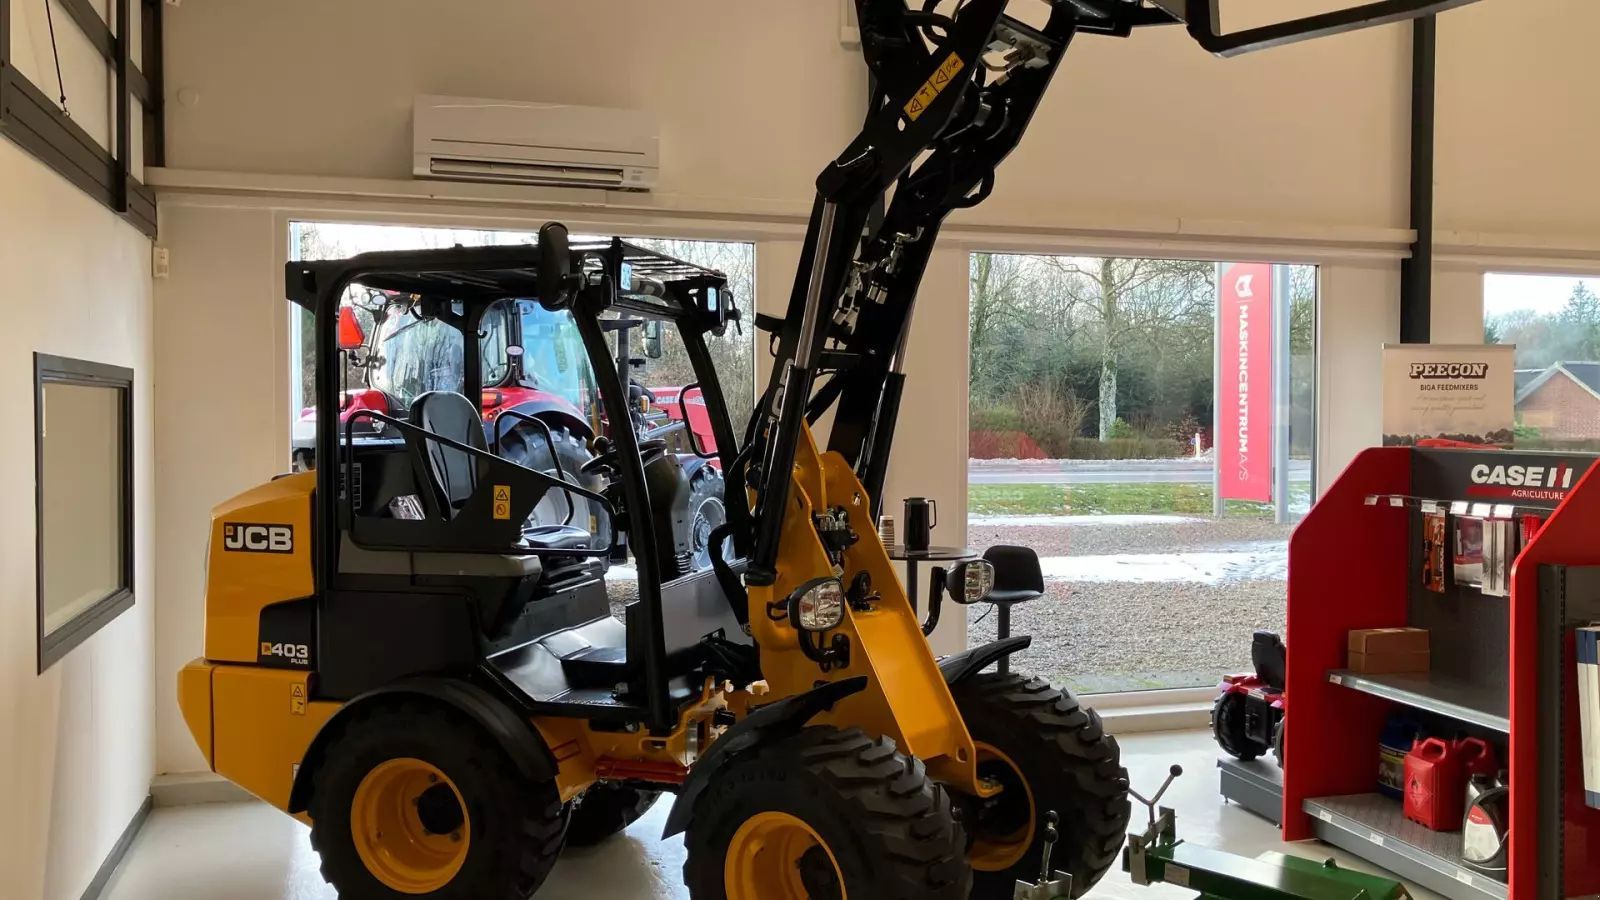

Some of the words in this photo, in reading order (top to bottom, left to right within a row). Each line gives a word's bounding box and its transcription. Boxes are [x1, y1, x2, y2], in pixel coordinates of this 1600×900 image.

[1409, 363, 1489, 379] PEECON
[1471, 464, 1544, 487] CASE
[1511, 489, 1564, 500] AGRICULTURE
[225, 525, 292, 551] JCB
[271, 643, 309, 658] 403
[290, 657, 309, 665] PLUS
